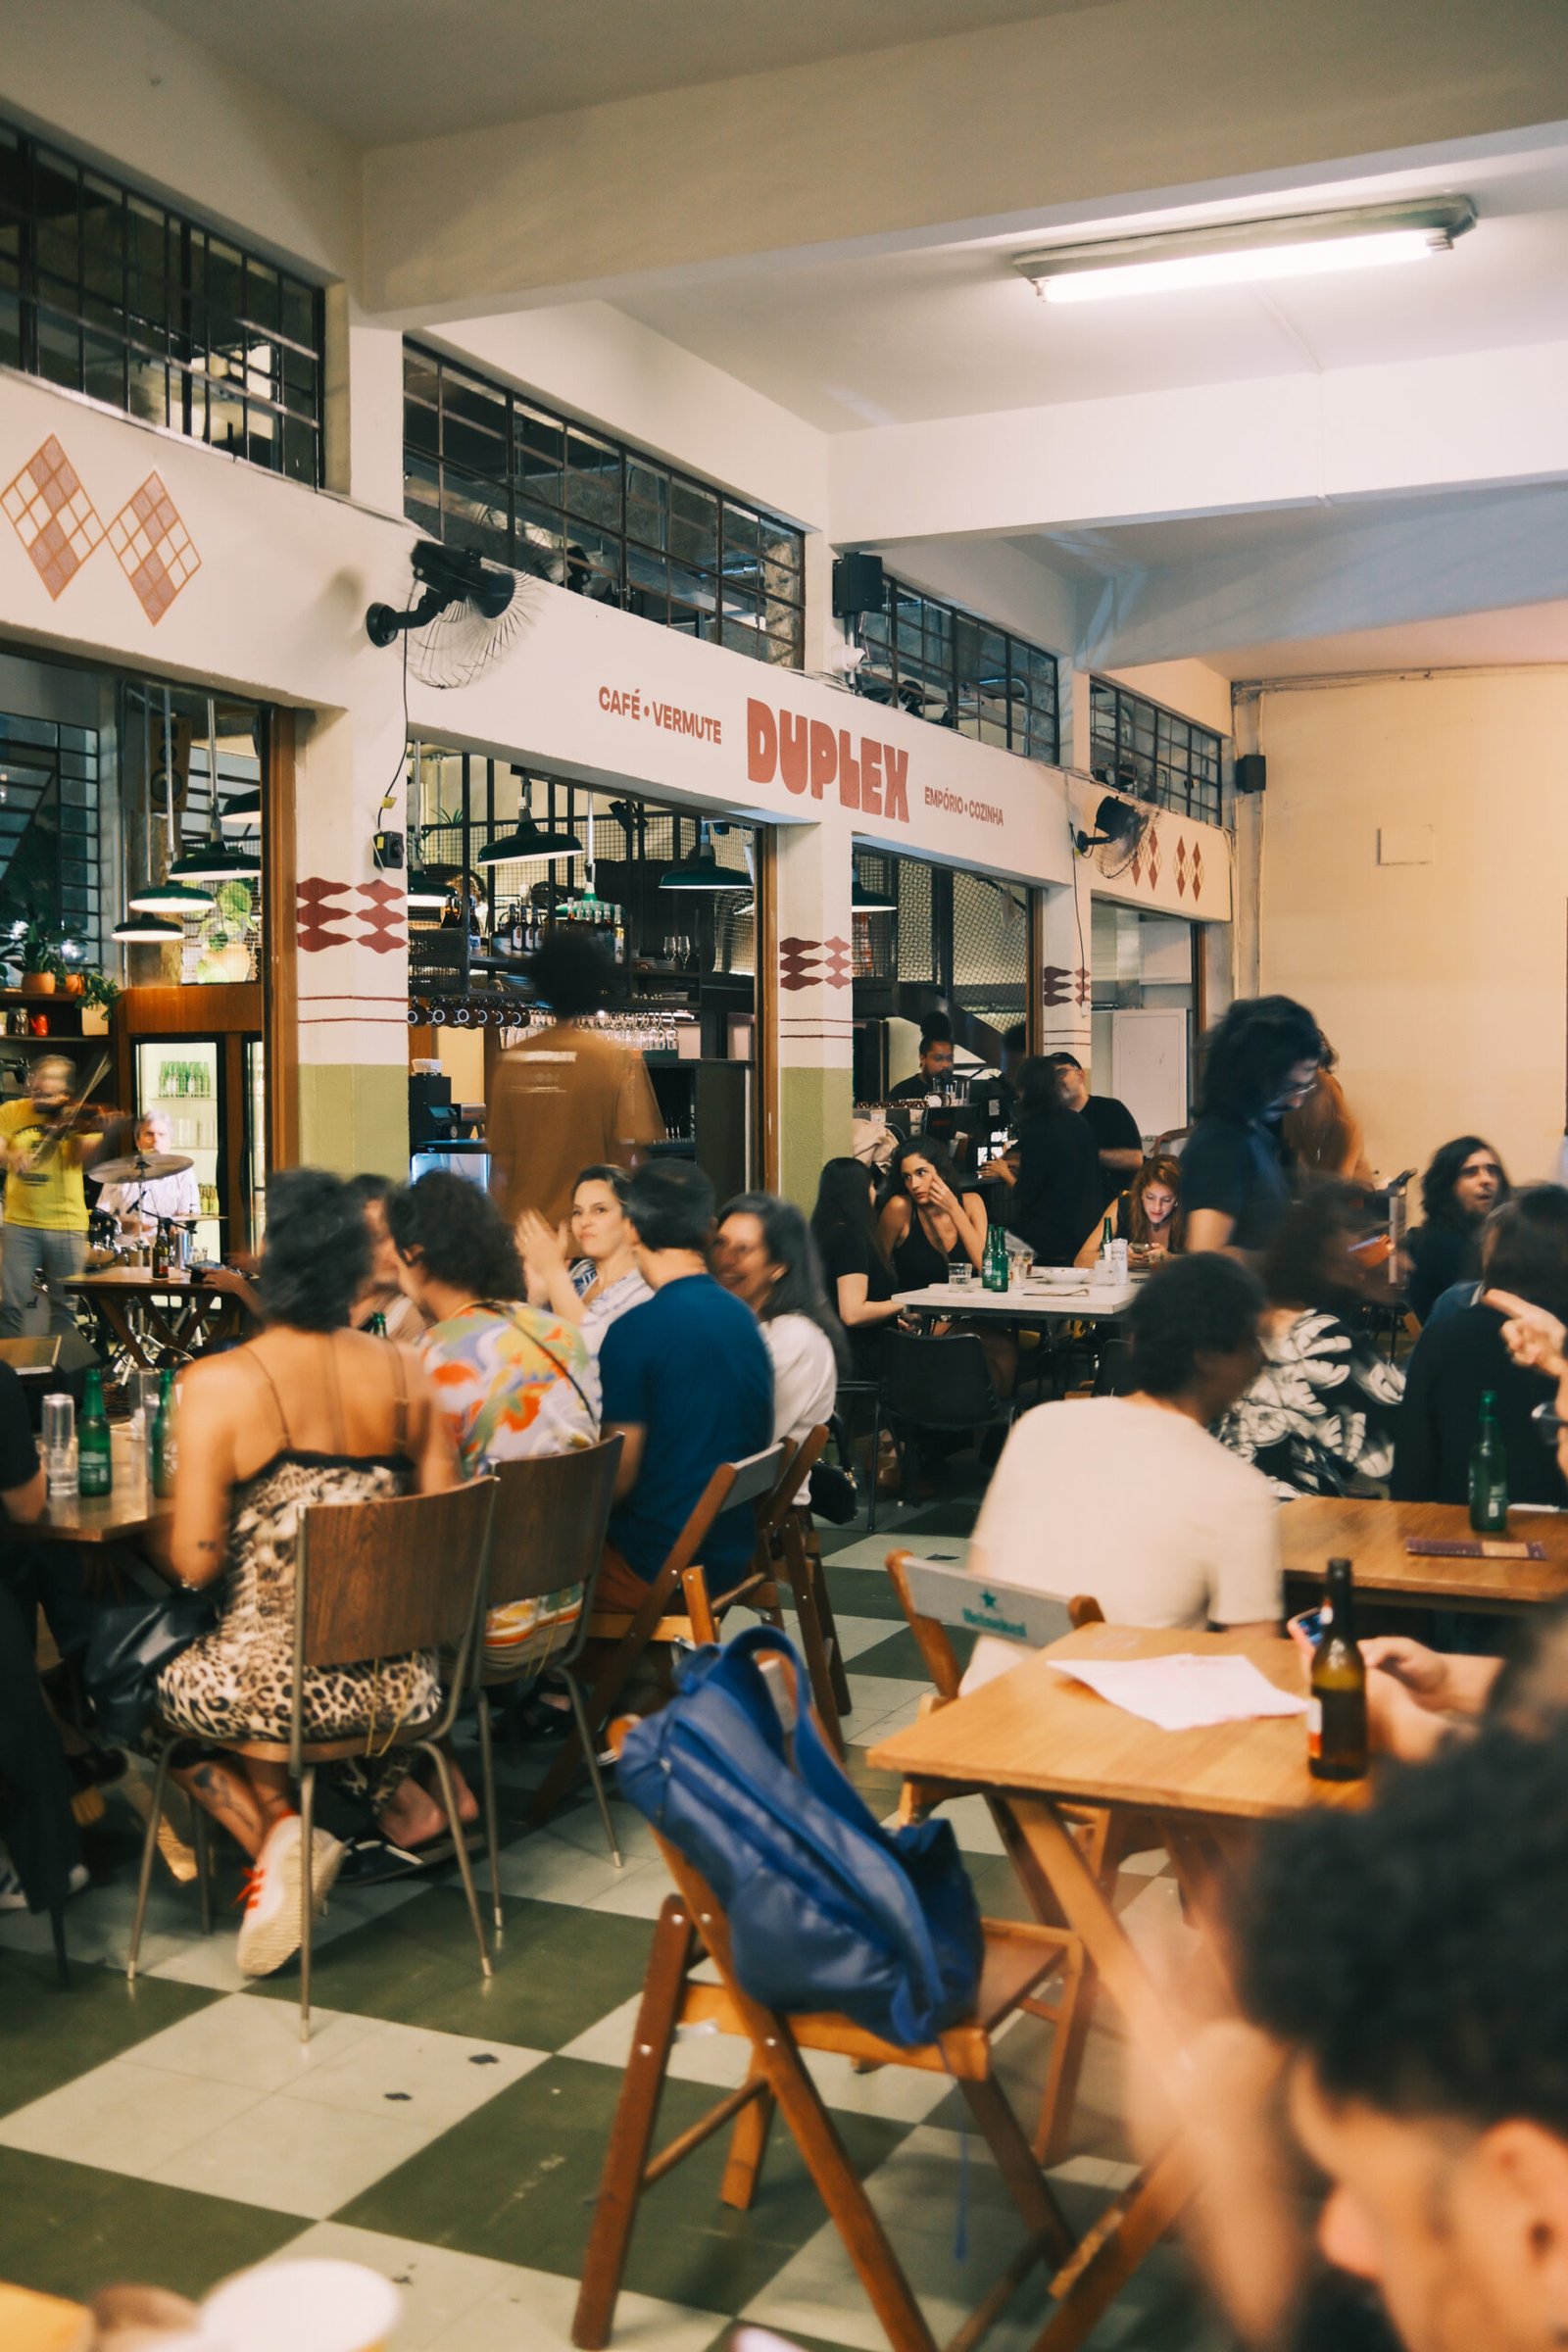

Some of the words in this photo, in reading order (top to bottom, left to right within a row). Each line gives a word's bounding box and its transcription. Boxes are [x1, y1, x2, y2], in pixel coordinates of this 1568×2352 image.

[599, 686, 640, 720] CAFÉ
[653, 702, 721, 745] VERMUTE
[747, 697, 909, 823] DUPLEX
[924, 786, 963, 814] EMPÓRIO
[969, 800, 1004, 826] COZINHA
